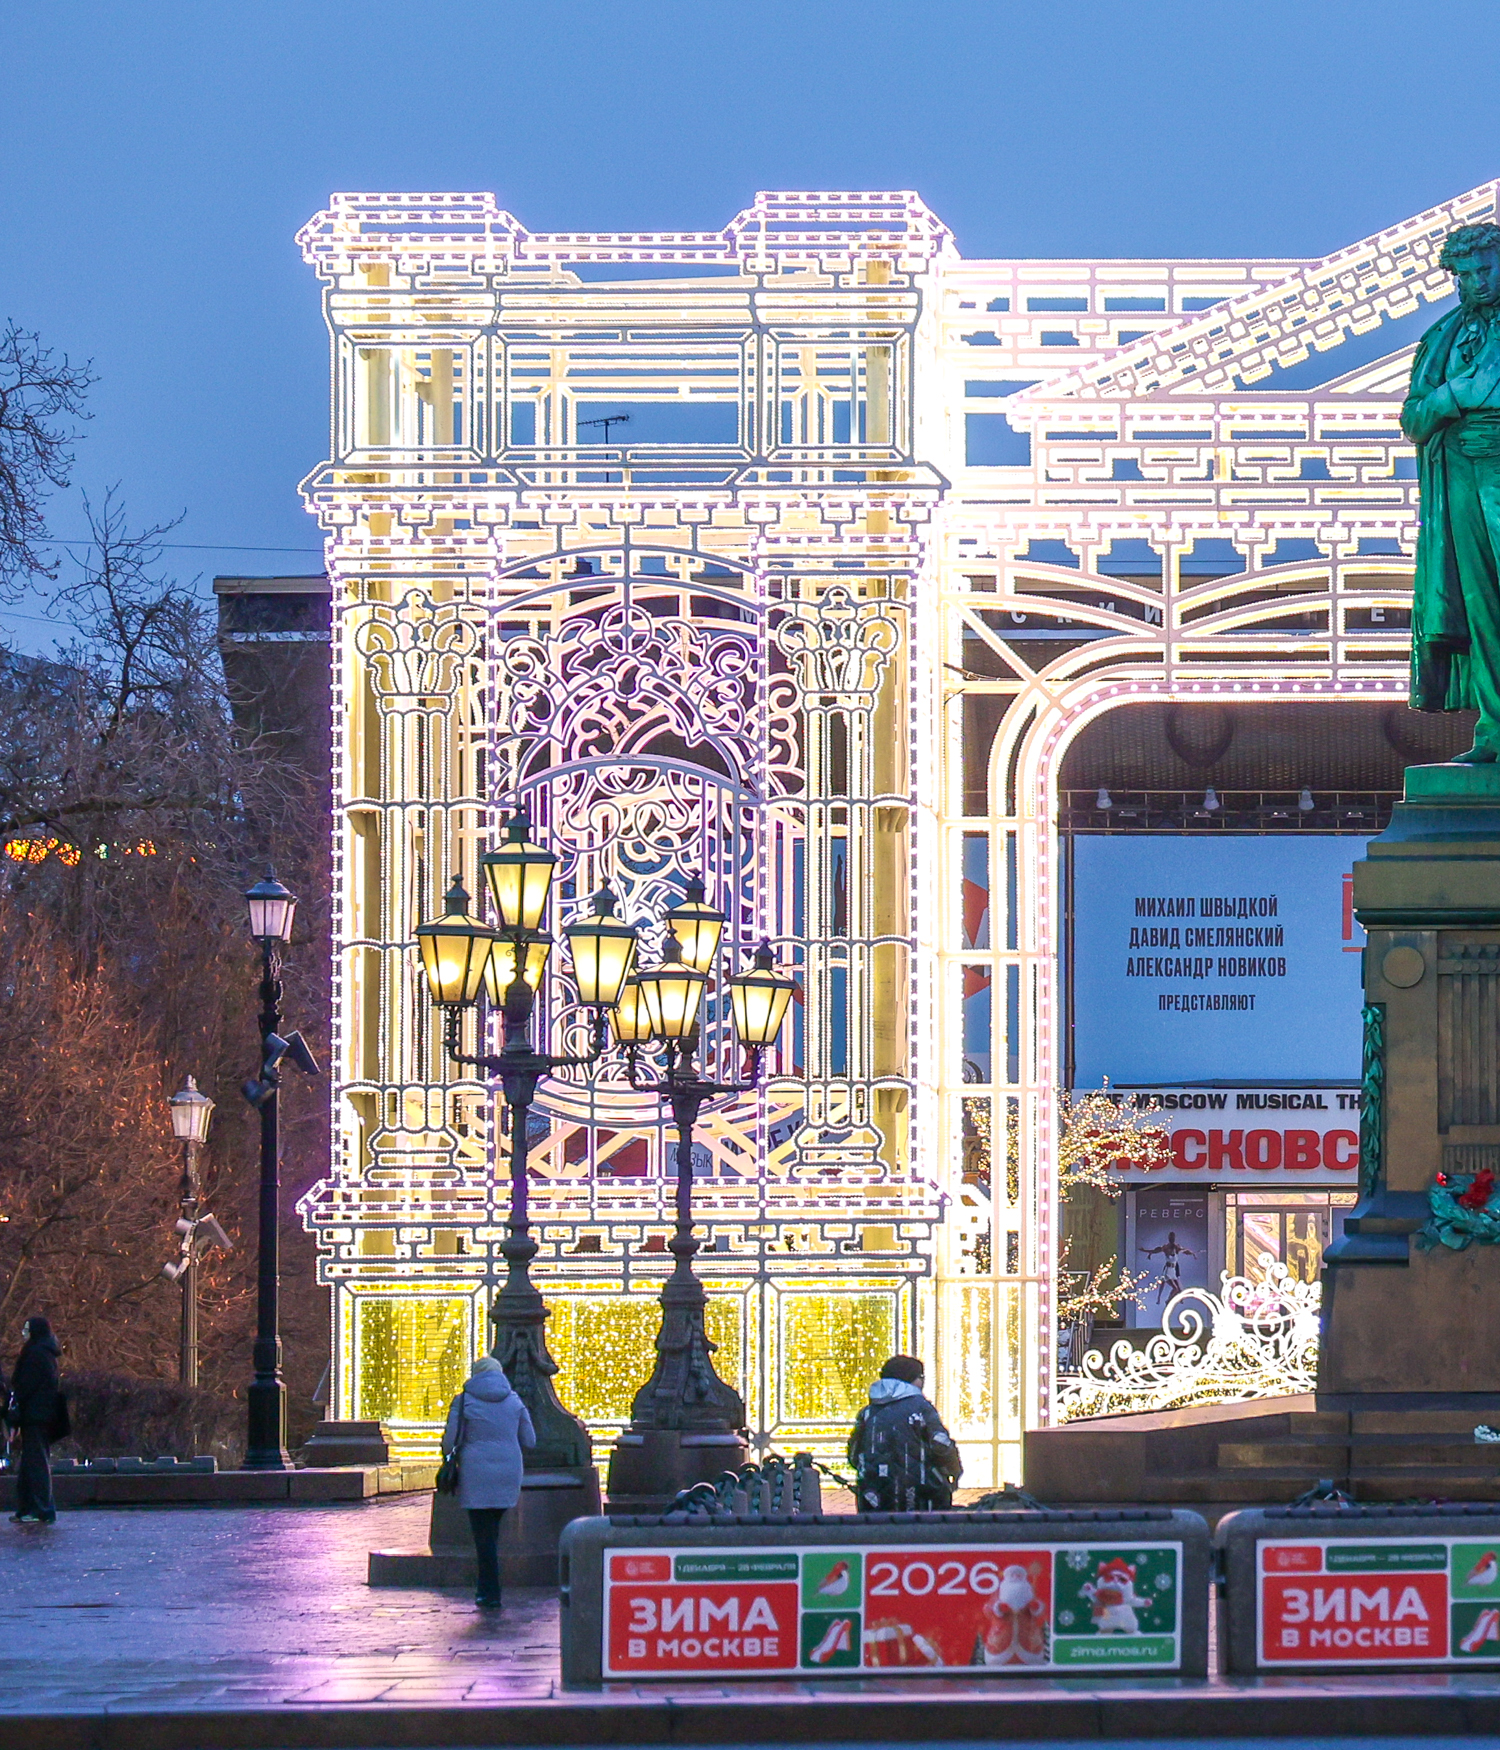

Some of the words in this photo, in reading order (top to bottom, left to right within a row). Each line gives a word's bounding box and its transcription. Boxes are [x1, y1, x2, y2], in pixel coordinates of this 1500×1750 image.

[1134, 897, 1195, 918] МИХАИЛ
[1200, 894, 1278, 919] ШВЫДКОЙ
[1128, 927, 1181, 949] ДАВИД
[1185, 924, 1284, 948] СМЕЛЯНСКИЙ
[1126, 957, 1214, 979] АЛЕКСАНДР
[1217, 957, 1286, 977] НОВИКОВ
[1158, 994, 1256, 1013] ПРЕДСТАВЛЯЮТ
[1084, 1093, 1124, 1110] HE
[1133, 1093, 1228, 1110] MOSCOW
[1236, 1093, 1329, 1110] MUSICAL
[1139, 1209, 1204, 1218] РЕВЕРС
[870, 1561, 999, 1596] 2026
[628, 1596, 779, 1633] ЗИМА
[1281, 1586, 1429, 1622] ЗИМА
[628, 1638, 647, 1658] В
[656, 1637, 779, 1658] МОСКВЕ
[1281, 1628, 1300, 1647] В
[1309, 1627, 1429, 1647] МОСКВЕ
